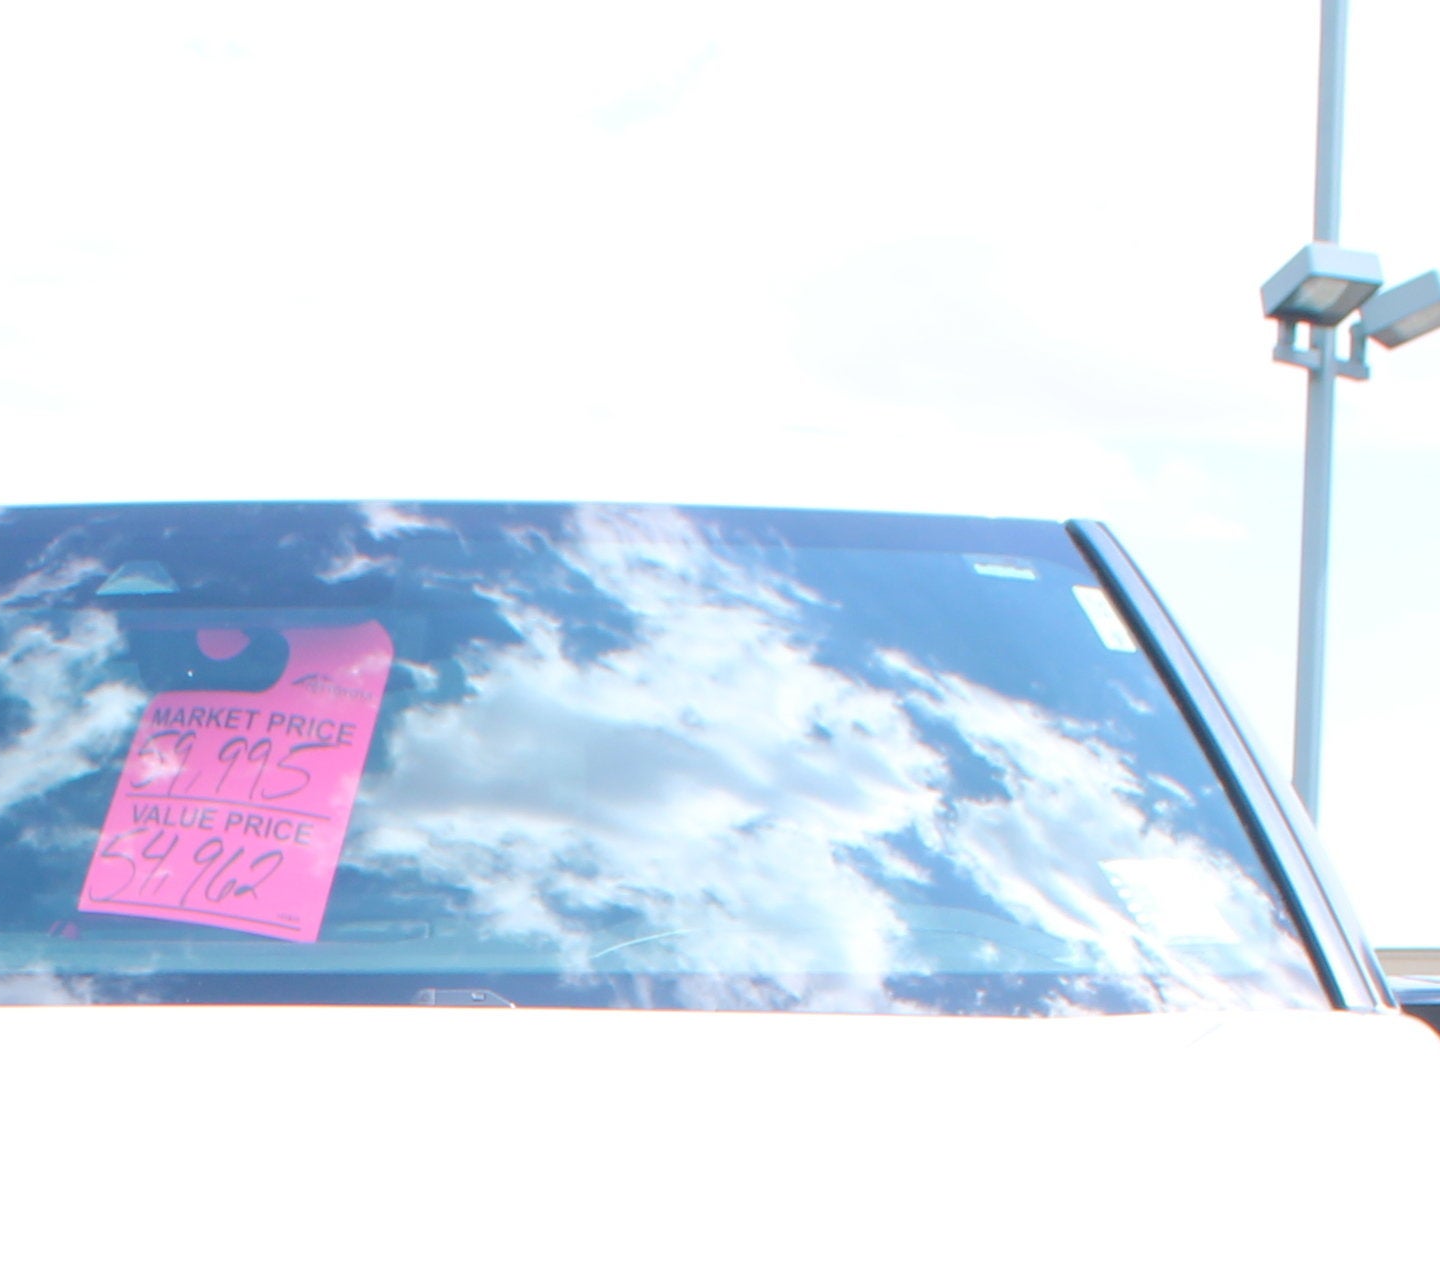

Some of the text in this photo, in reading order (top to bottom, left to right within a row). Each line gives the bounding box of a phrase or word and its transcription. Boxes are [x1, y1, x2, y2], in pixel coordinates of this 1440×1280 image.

[151, 705, 357, 747] MARKET PRICE
[131, 804, 314, 845] VALUE PRICE
